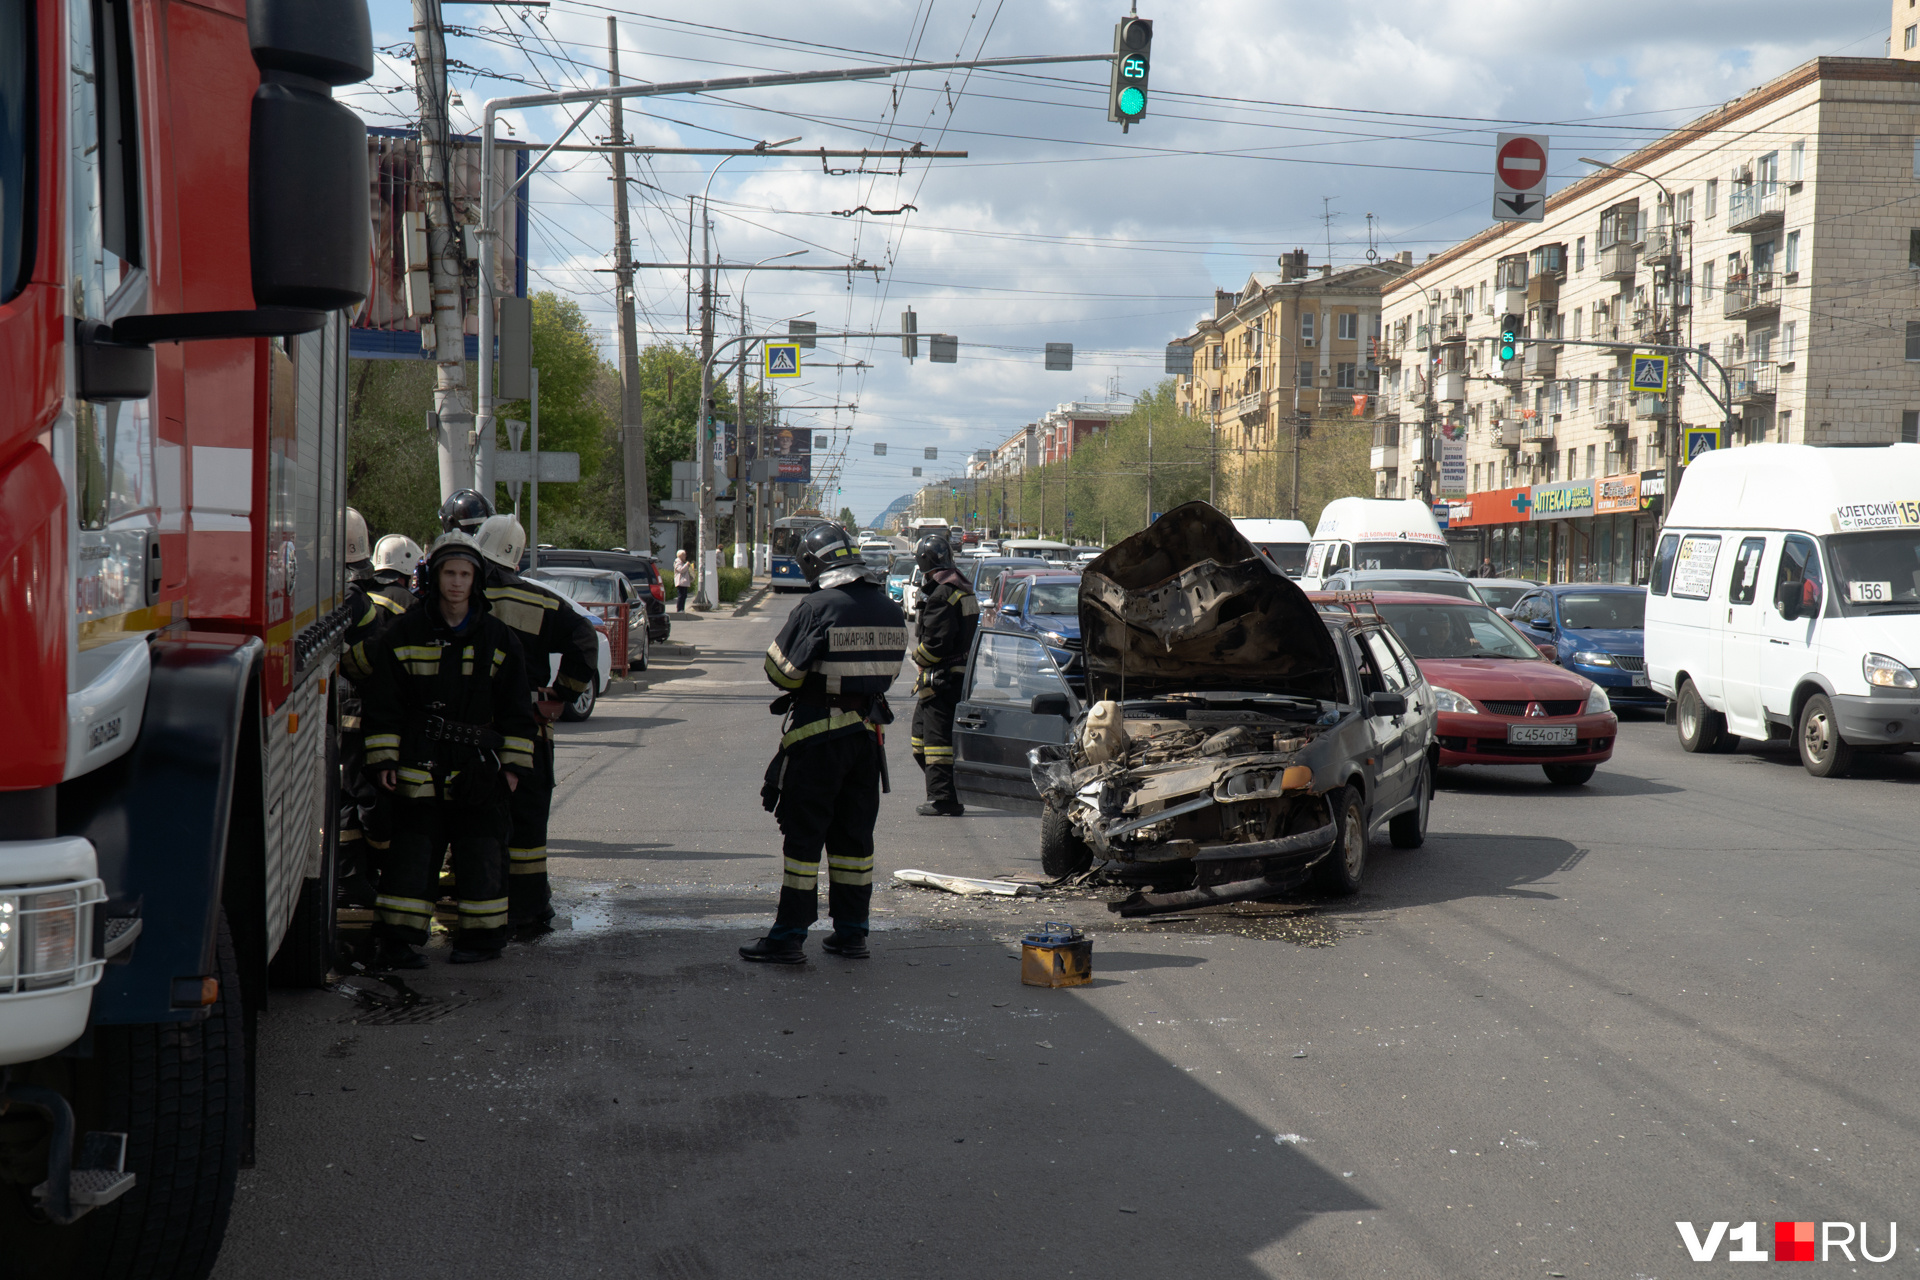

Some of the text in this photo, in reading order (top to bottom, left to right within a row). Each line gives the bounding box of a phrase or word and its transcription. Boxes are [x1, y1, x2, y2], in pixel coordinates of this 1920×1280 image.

[1124, 59, 1145, 78] 25
[1503, 332, 1514, 343] 25
[1571, 486, 1590, 497] ПЛАНЕТА
[1534, 489, 1566, 512] АПТЕКА
[1837, 501, 1920, 523] КЛЕТСКИЙ 15
[1854, 516, 1902, 527] (РАССВЕТ)
[1398, 531, 1407, 540] 4
[349, 543, 356, 553] 3
[504, 544, 513, 554] 3
[1858, 584, 1882, 599] 156
[833, 632, 905, 646] ПОЖАРНАЯ ОХРАНА
[1562, 728, 1573, 738] 34
